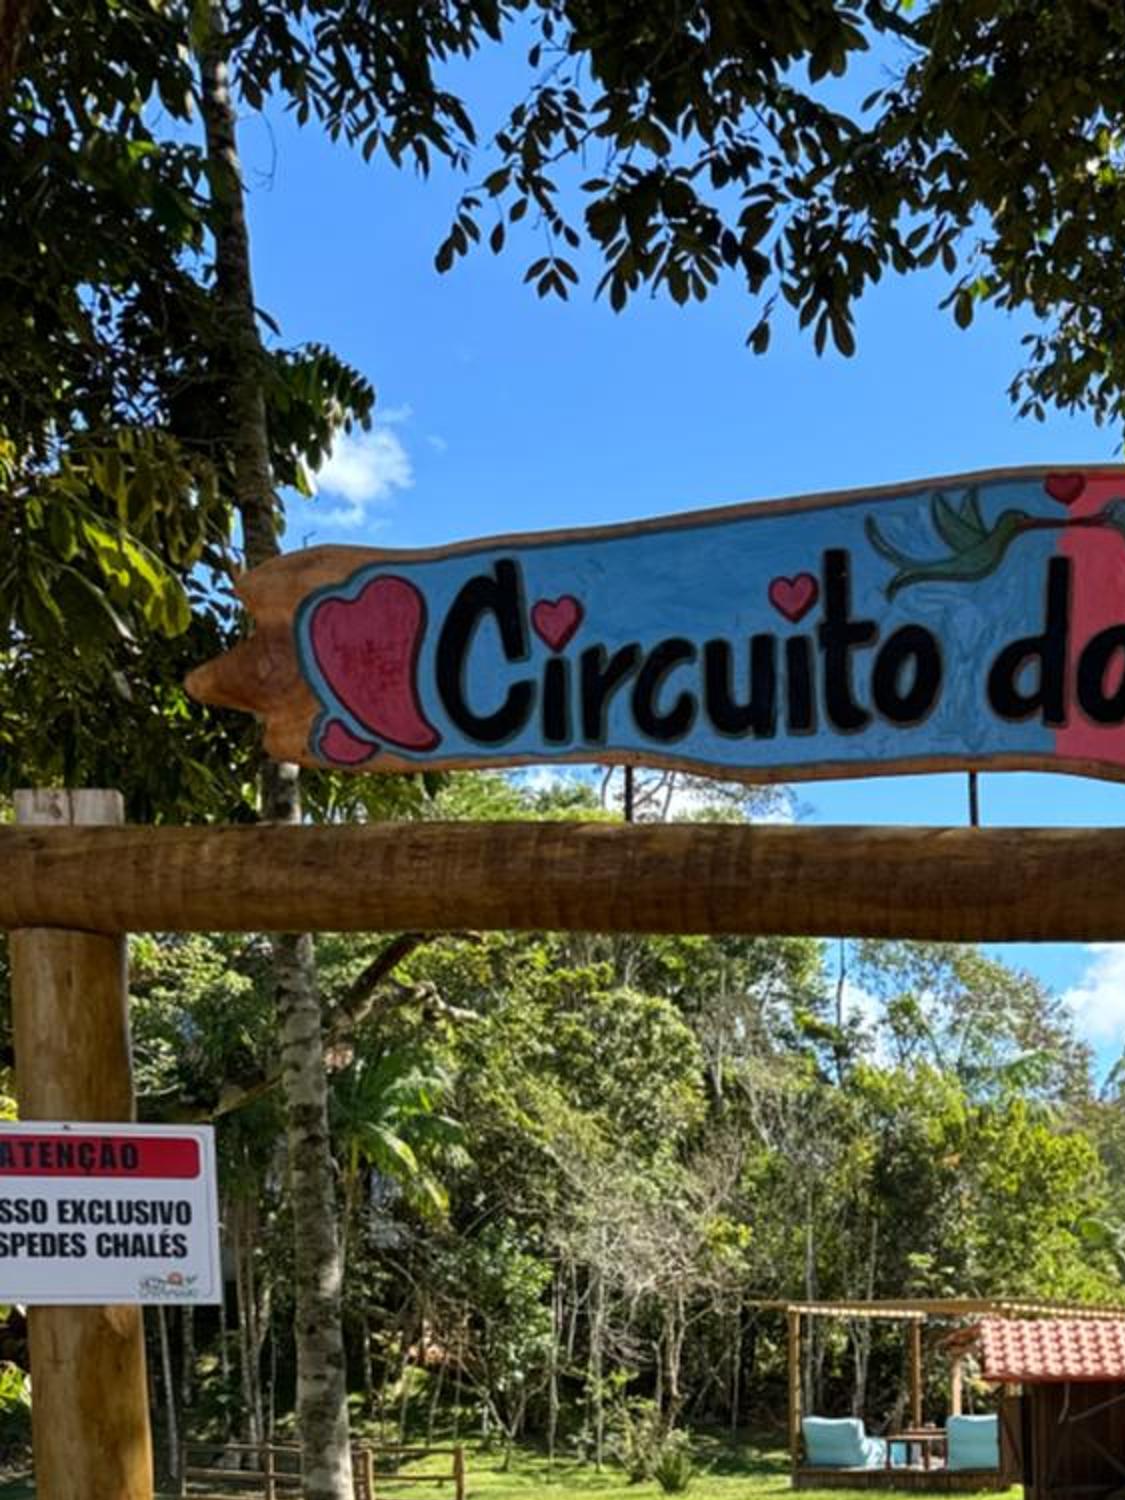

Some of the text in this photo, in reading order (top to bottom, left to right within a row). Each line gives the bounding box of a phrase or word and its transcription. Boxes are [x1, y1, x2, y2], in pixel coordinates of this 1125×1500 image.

[435, 548, 943, 746] Circuito
[57, 1199, 192, 1226] EXCLUSIVO
[96, 1228, 188, 1258] CHALÉS
